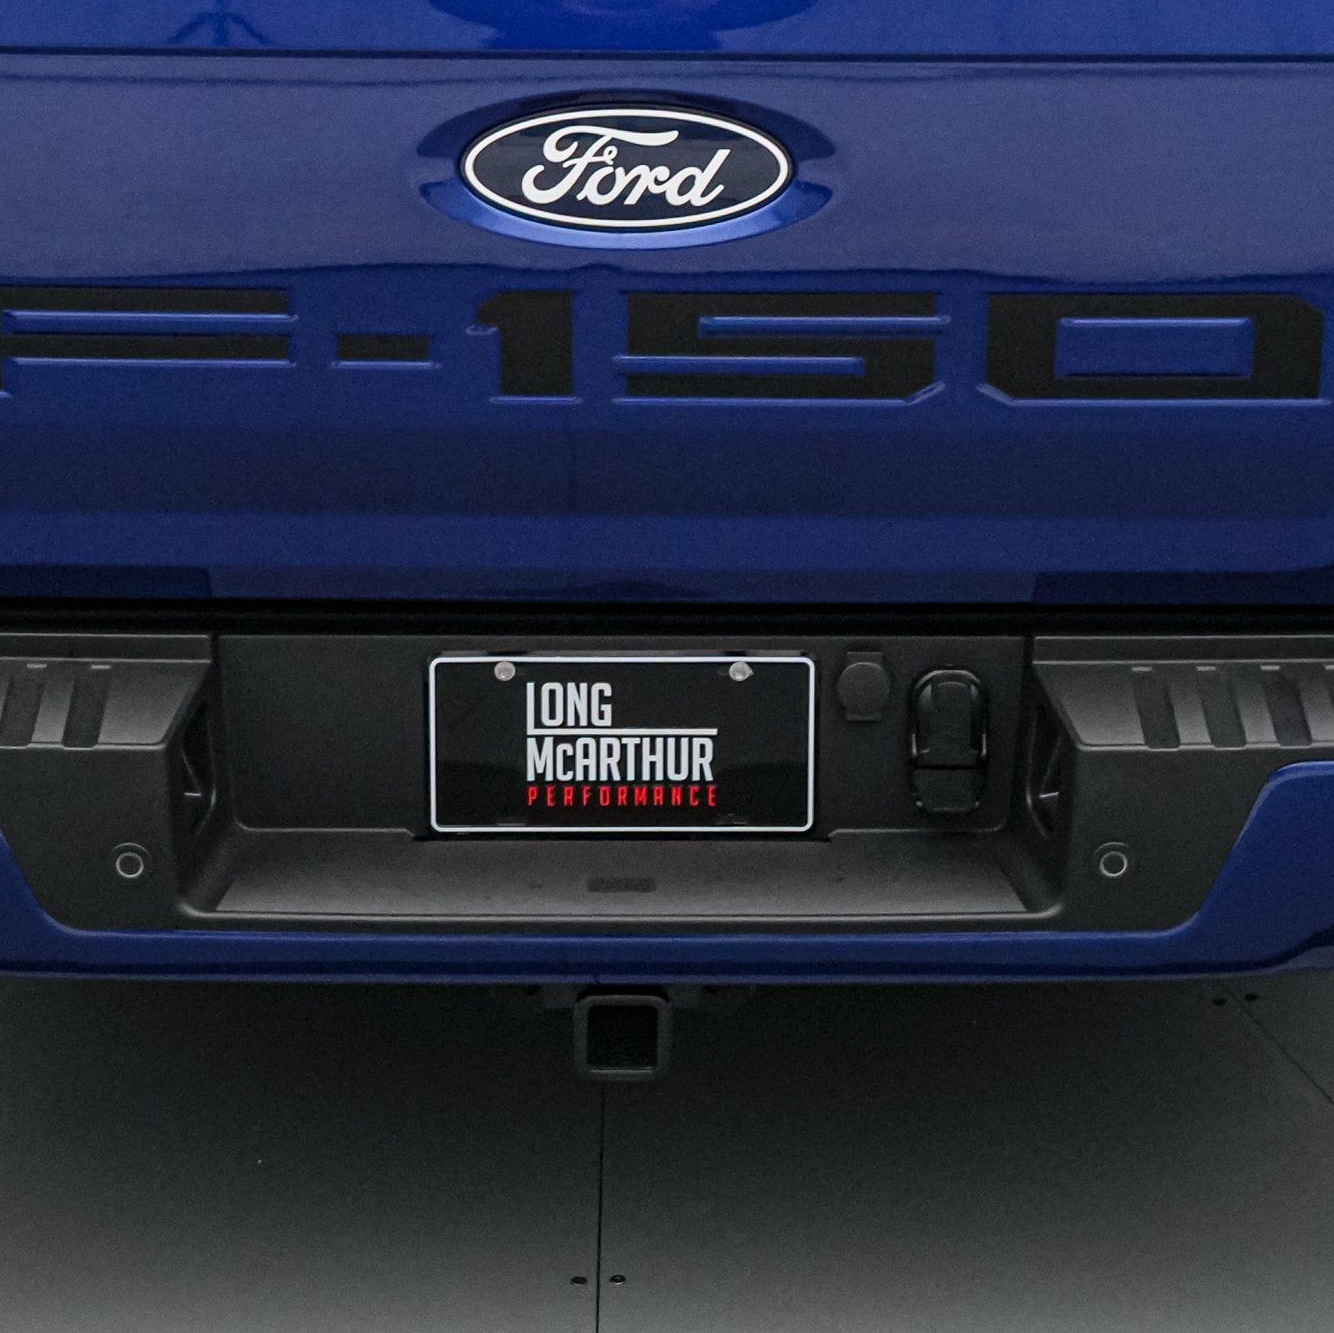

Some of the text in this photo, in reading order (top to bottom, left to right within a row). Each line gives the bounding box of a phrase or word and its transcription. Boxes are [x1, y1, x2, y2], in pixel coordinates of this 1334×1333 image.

[521, 125, 731, 207] Ford
[526, 682, 612, 734] LONG
[526, 737, 713, 782] McARTHUR
[527, 785, 717, 807] PERFORMANCE
